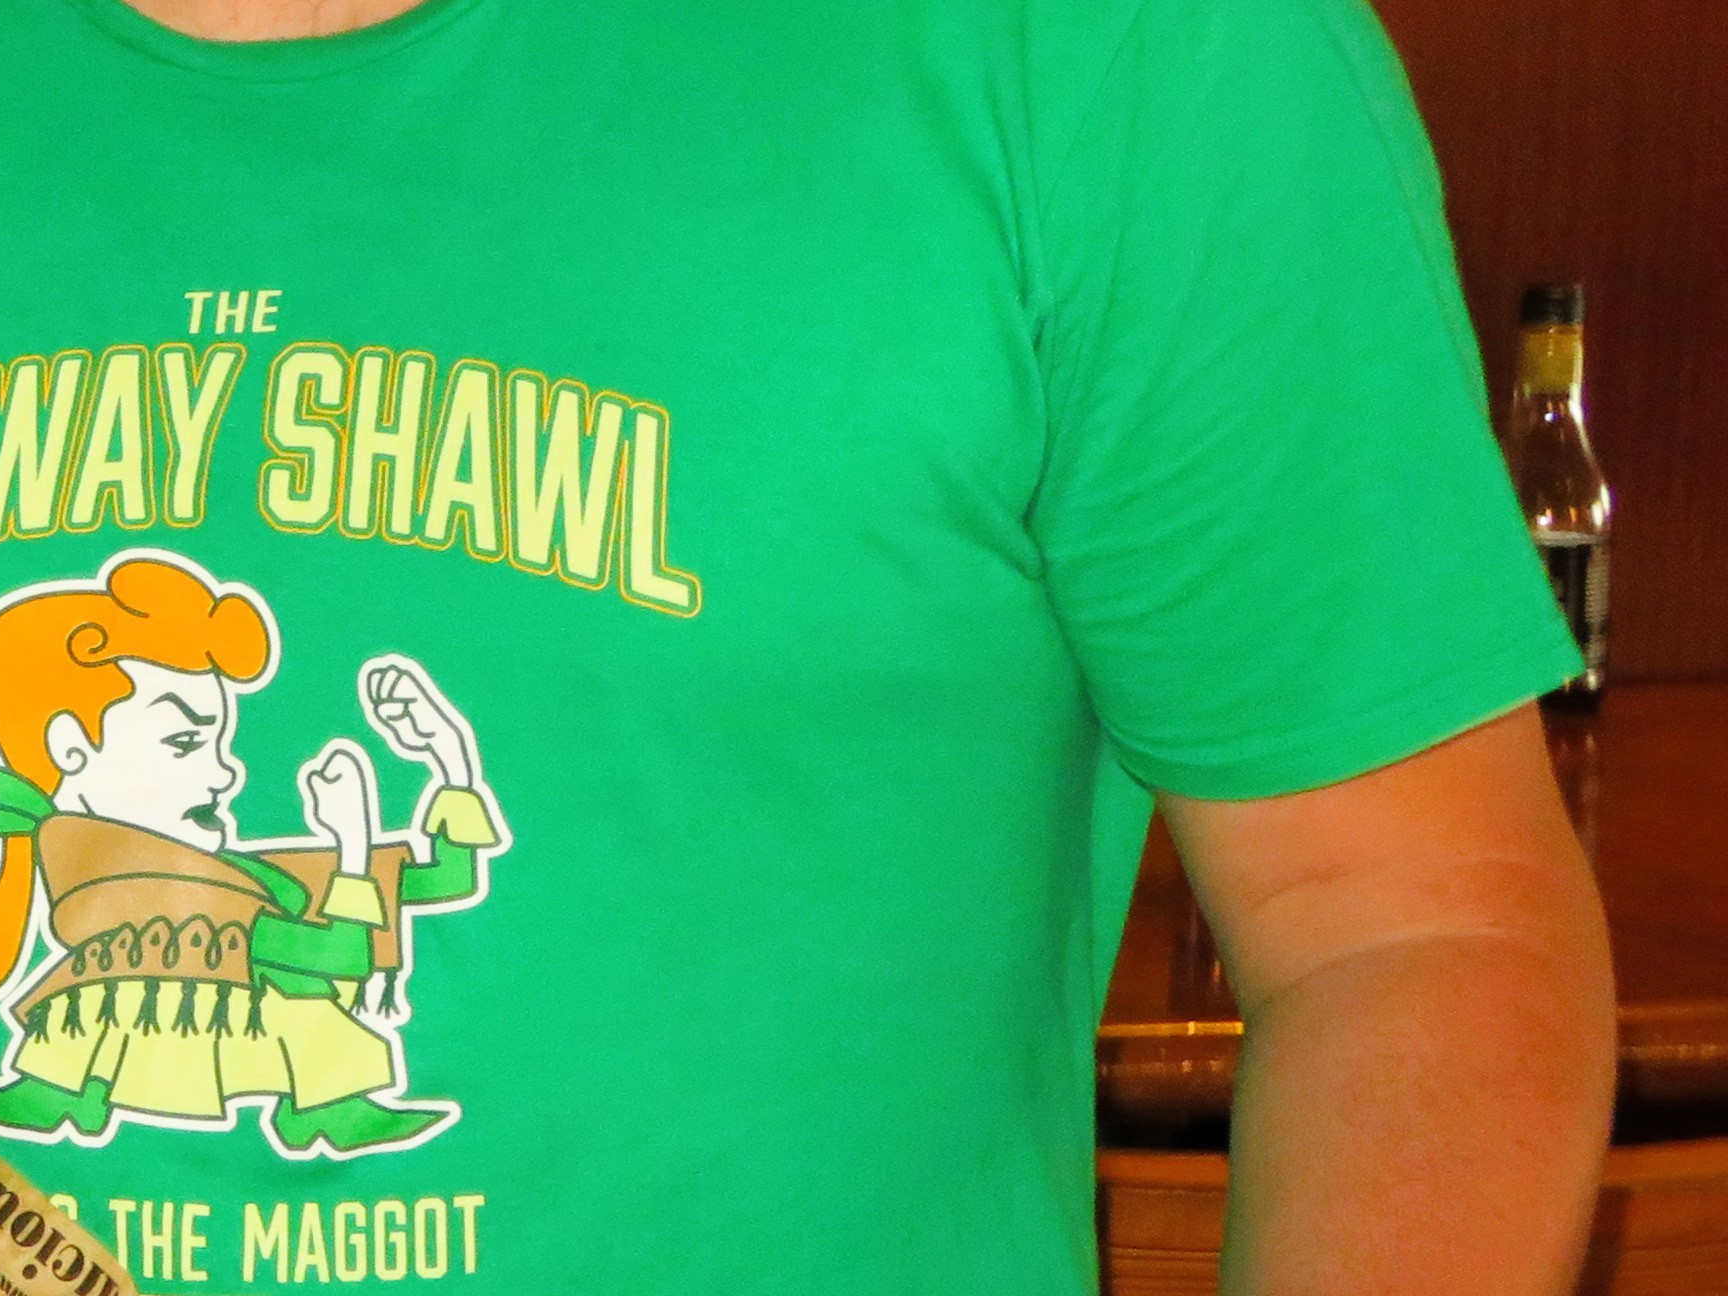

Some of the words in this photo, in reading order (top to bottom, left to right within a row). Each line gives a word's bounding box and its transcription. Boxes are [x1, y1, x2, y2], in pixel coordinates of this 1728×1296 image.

[183, 288, 283, 336] THE
[259, 341, 702, 618] SHAWL
[108, 1198, 211, 1283] THE
[242, 1194, 486, 1284] MAGGOT
